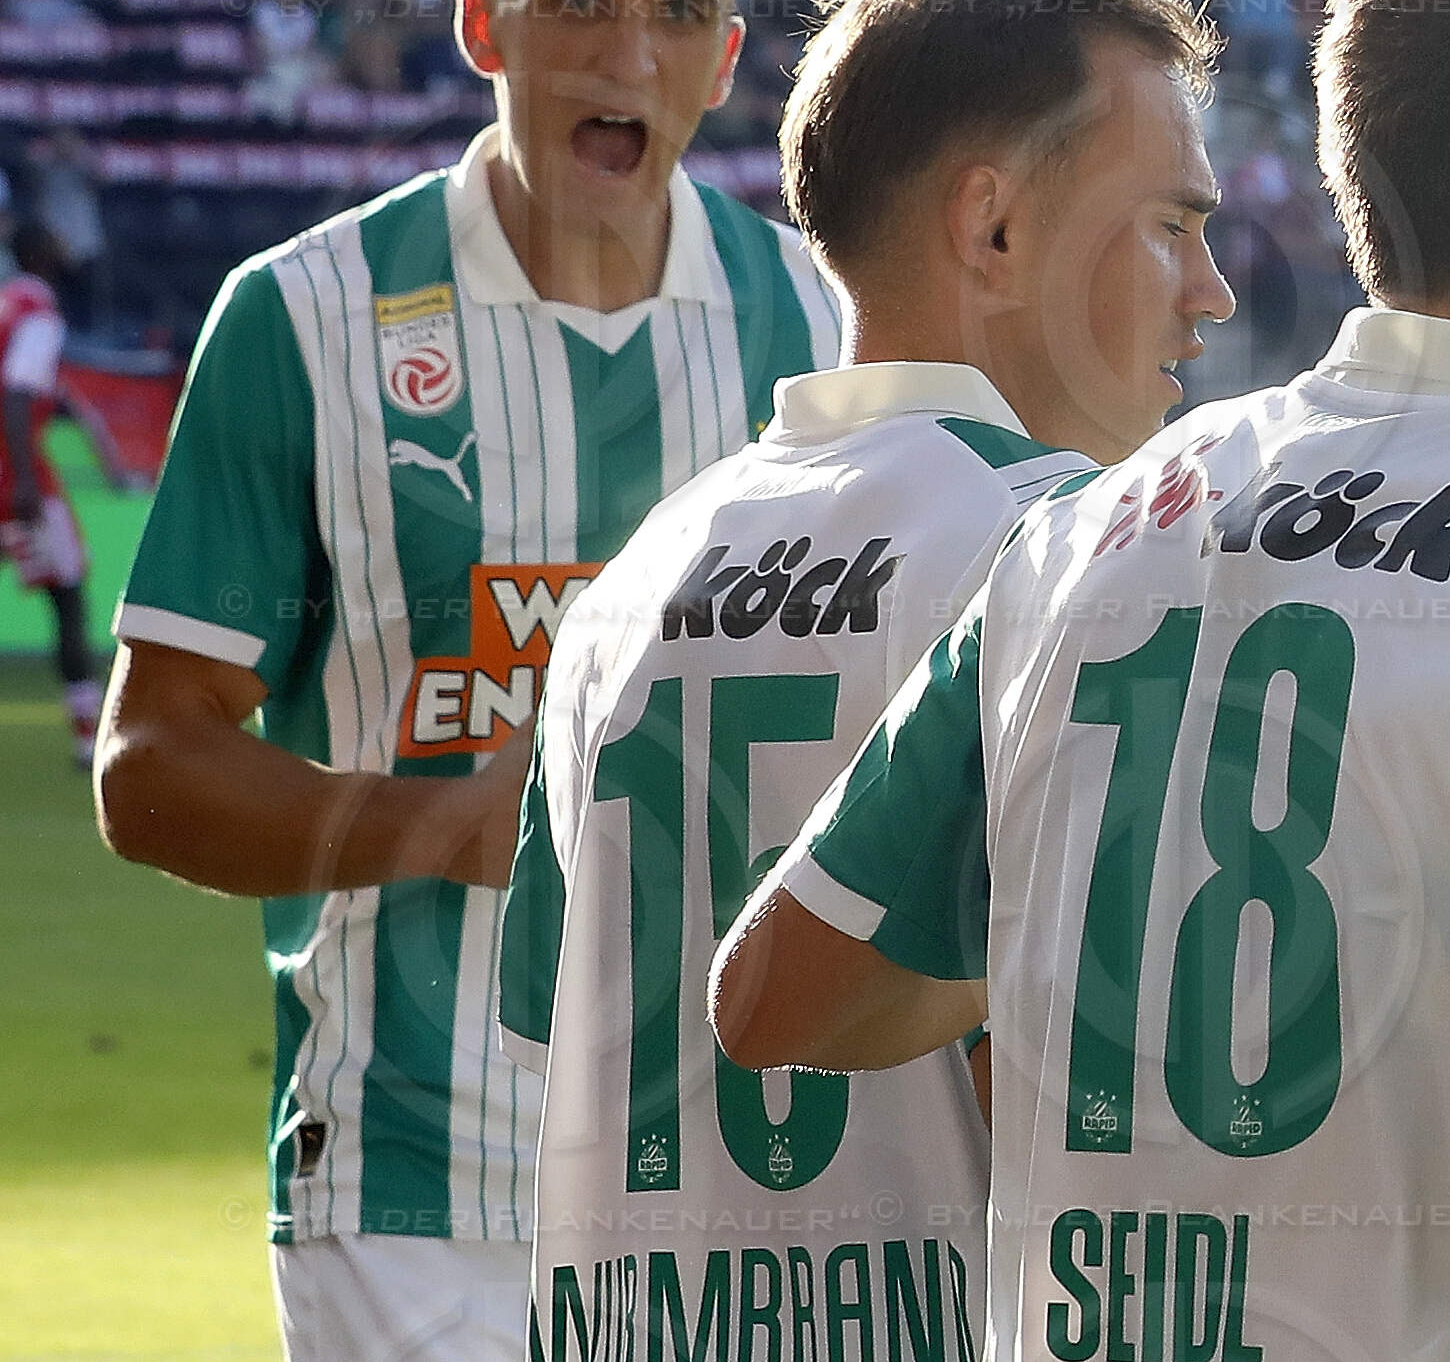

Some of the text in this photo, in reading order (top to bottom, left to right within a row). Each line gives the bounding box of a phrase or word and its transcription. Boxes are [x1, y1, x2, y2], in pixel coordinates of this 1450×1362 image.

[660, 535, 906, 642] köck
[592, 672, 852, 1194] 15
[1067, 599, 1358, 1158] 18
